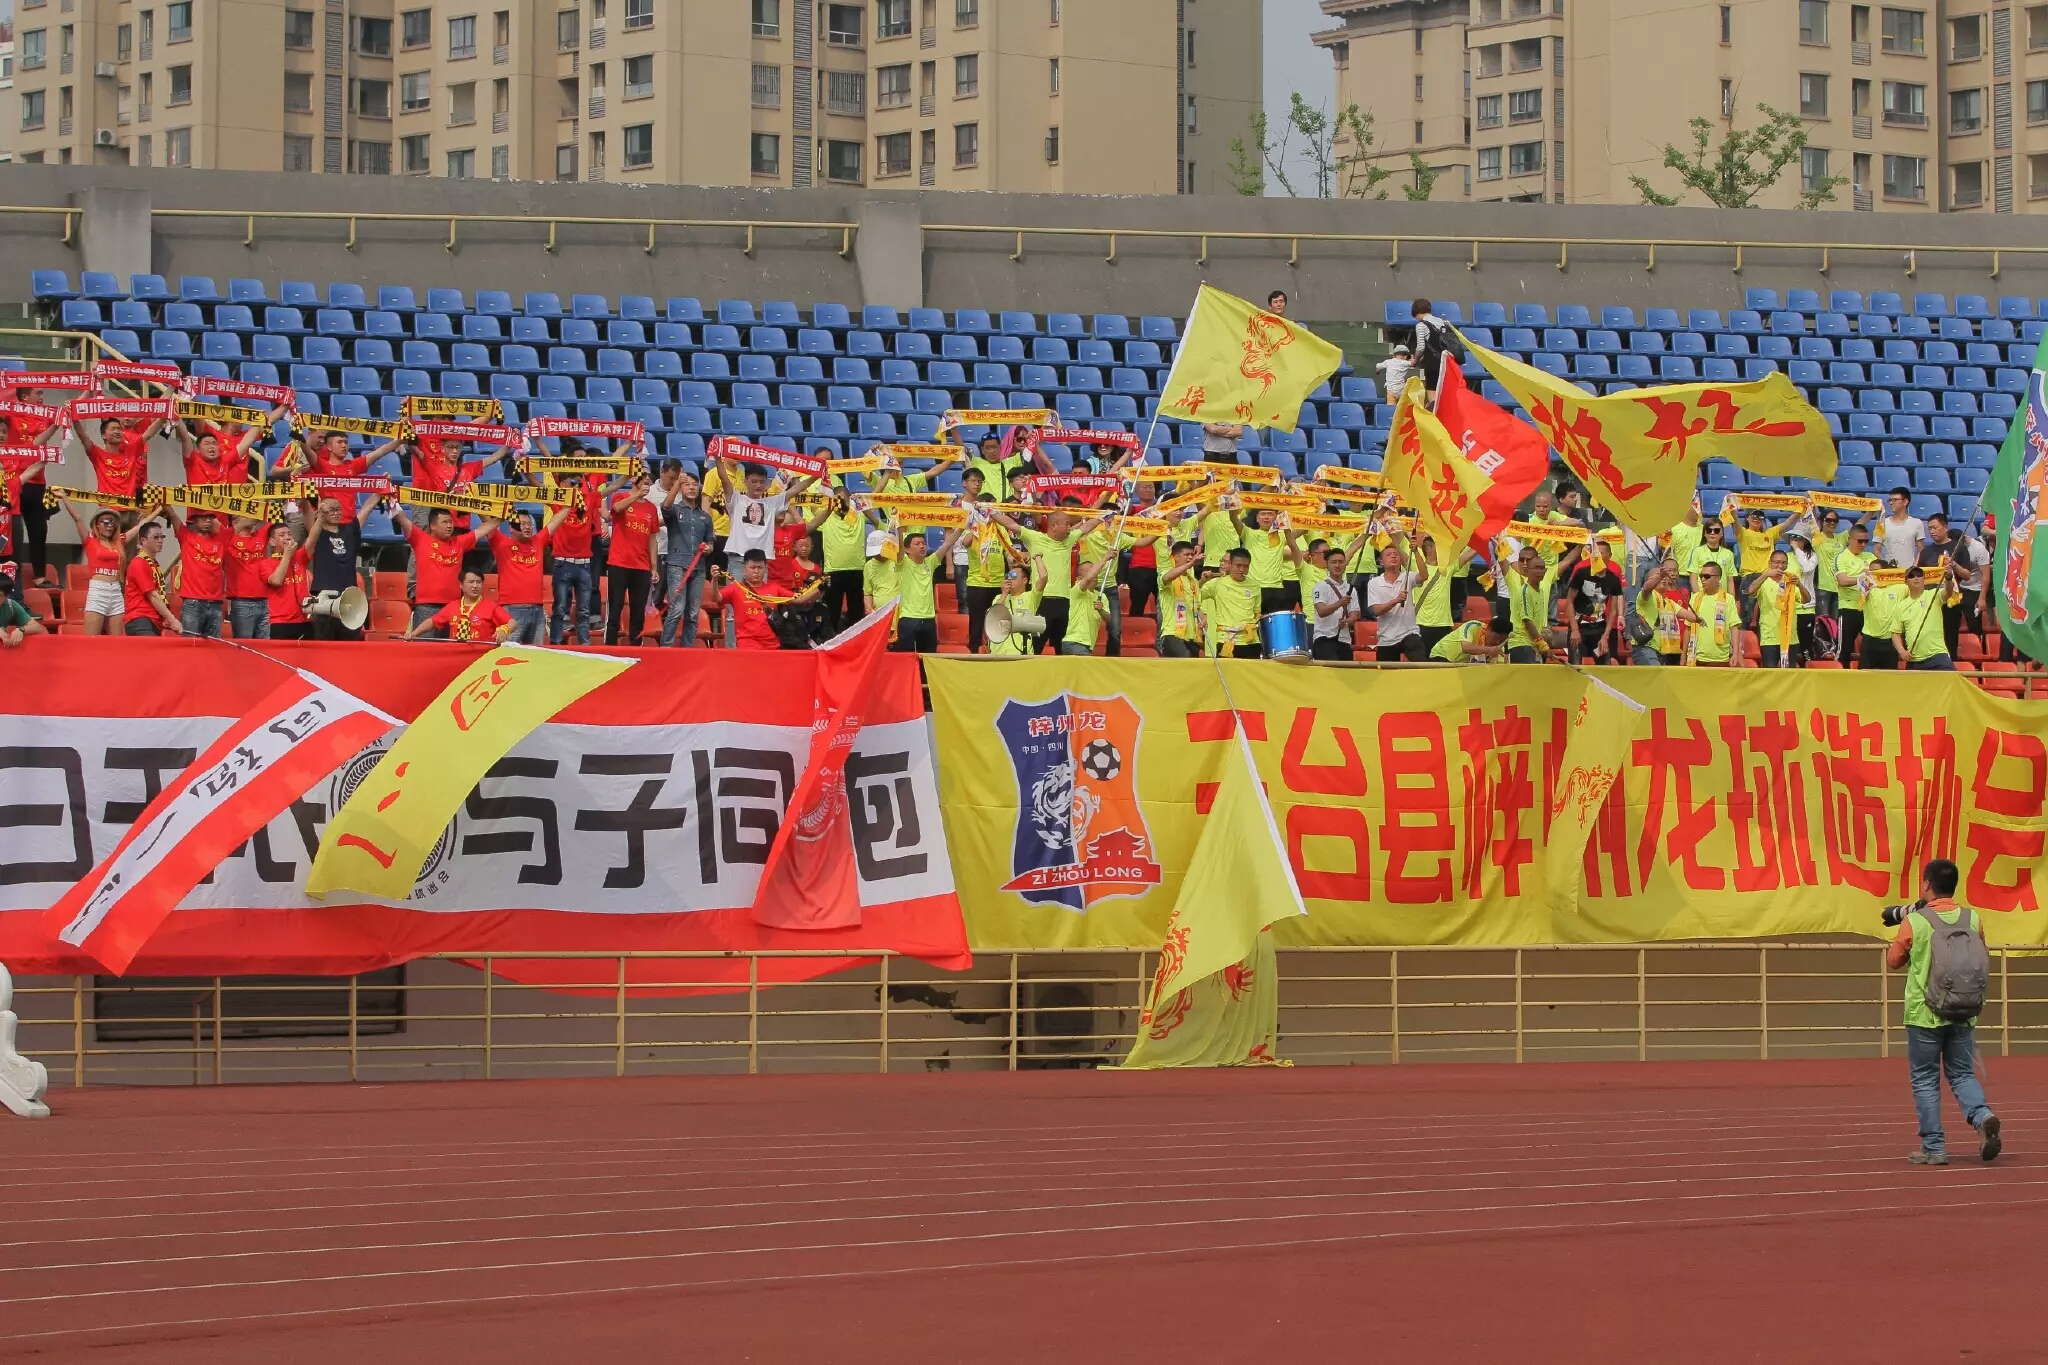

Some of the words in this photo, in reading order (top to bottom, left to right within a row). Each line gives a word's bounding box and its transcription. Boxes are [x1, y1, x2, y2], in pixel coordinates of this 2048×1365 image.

[178, 403, 206, 415] 四川
[418, 399, 443, 412] 四川
[310, 413, 340, 427] 四川
[364, 420, 394, 434] 雄起
[727, 443, 822, 472] 四川安纳普尔那
[174, 487, 203, 505] 四川
[228, 498, 259, 515] 雄起
[478, 483, 509, 499] 四川
[535, 486, 567, 502] 雄起
[1028, 711, 1106, 738] 梓州龙
[1032, 873, 1047, 885] ZI
[1052, 869, 1090, 883] ZHOU
[1094, 866, 1143, 878] LONG
